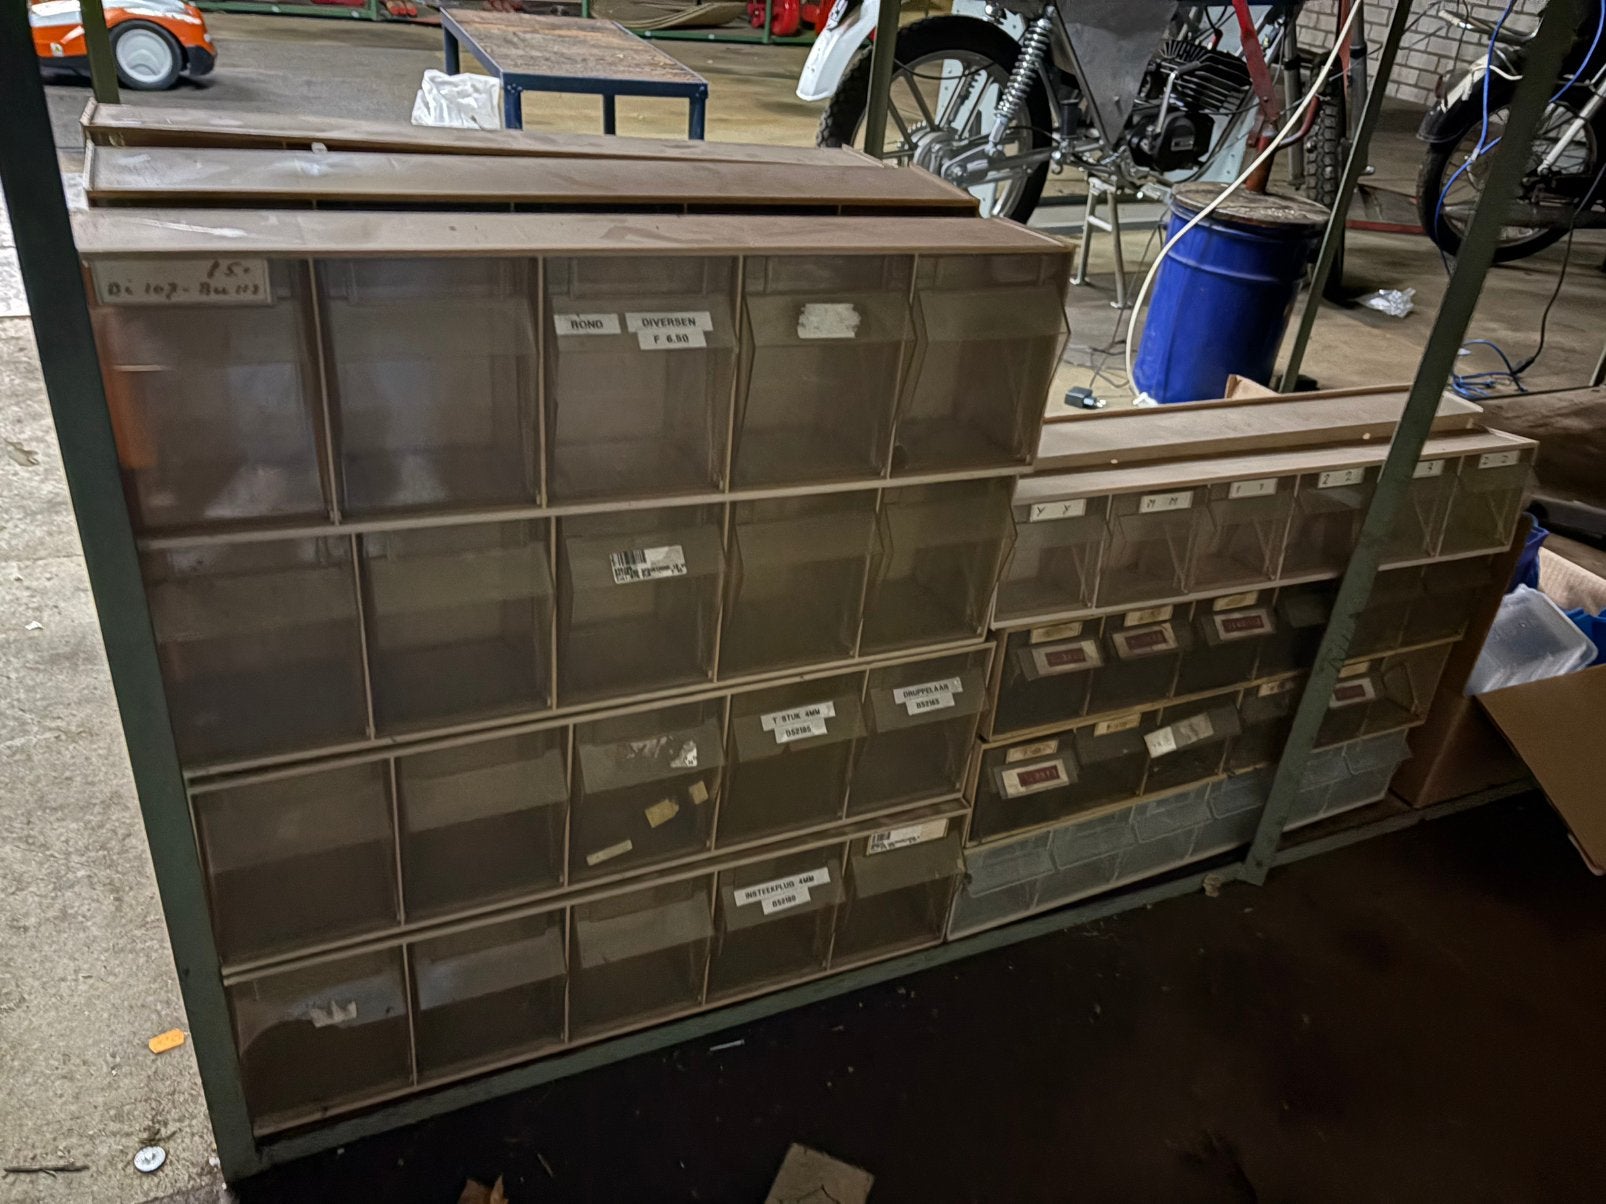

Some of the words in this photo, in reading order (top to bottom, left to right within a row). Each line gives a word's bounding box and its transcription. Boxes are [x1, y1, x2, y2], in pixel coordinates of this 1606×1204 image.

[571, 319, 603, 330] ROND
[641, 317, 697, 328] DIVERSEN
[653, 335, 660, 344] F
[902, 683, 950, 698] DRUPPELAAR
[804, 707, 821, 718] 4MM
[745, 880, 796, 900] INSTEEKPLUG
[798, 874, 815, 885] 4MM
